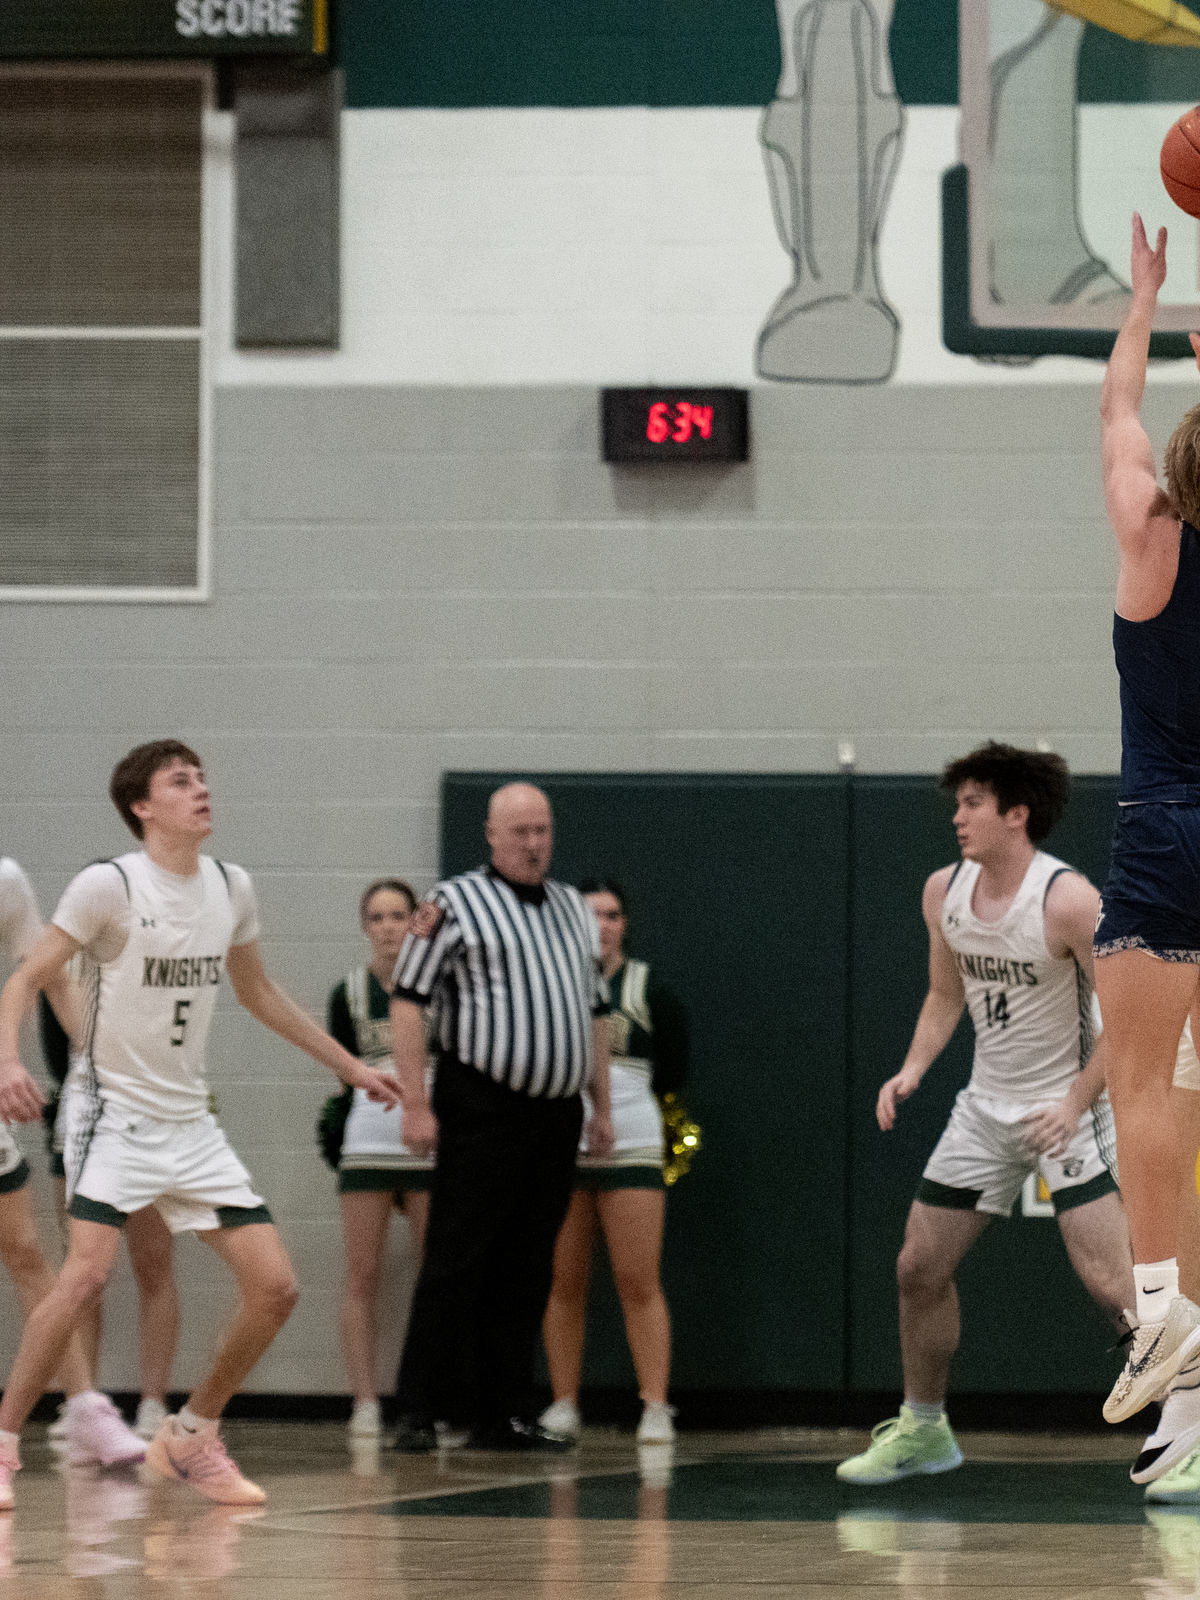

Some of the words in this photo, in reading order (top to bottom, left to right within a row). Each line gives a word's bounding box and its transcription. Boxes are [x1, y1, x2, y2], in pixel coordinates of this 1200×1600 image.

[175, 0, 300, 37] SCORE
[142, 955, 221, 988] KNIGHTS
[170, 1000, 191, 1047] 5
[984, 989, 1010, 1030] 14
